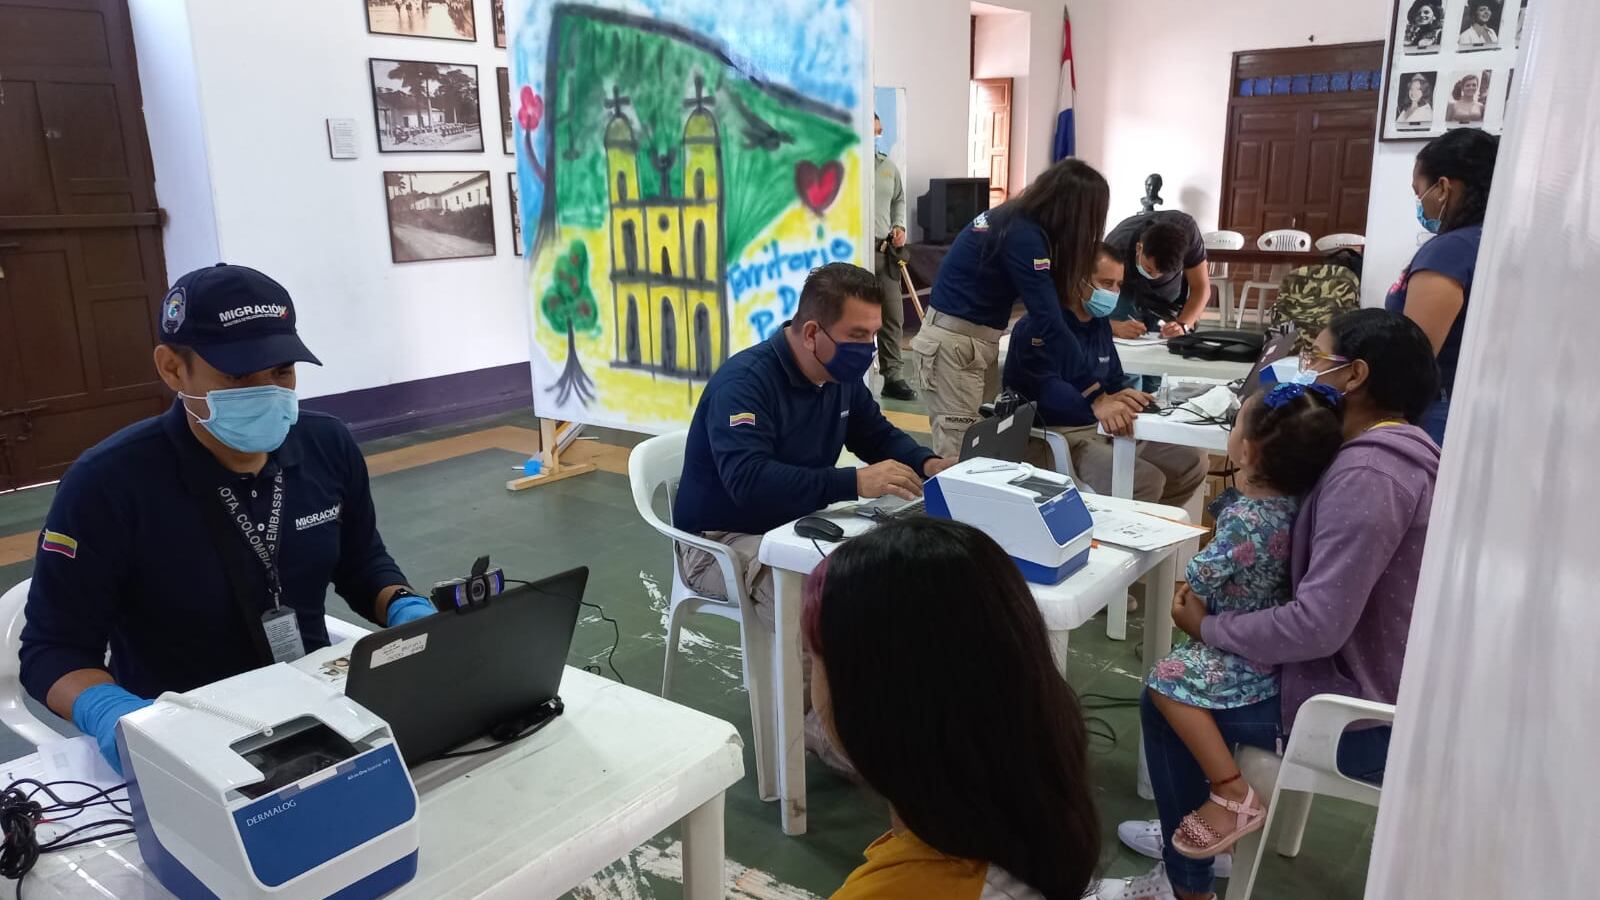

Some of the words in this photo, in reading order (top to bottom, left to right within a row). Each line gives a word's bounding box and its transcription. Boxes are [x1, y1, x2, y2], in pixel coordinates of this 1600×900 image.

[219, 303, 284, 322] MIGRACIÓN
[217, 487, 240, 514] OTA,
[236, 513, 273, 569] COLOMBIA
[266, 485, 282, 541] EMBASSY
[246, 799, 297, 827] DERMALOG
